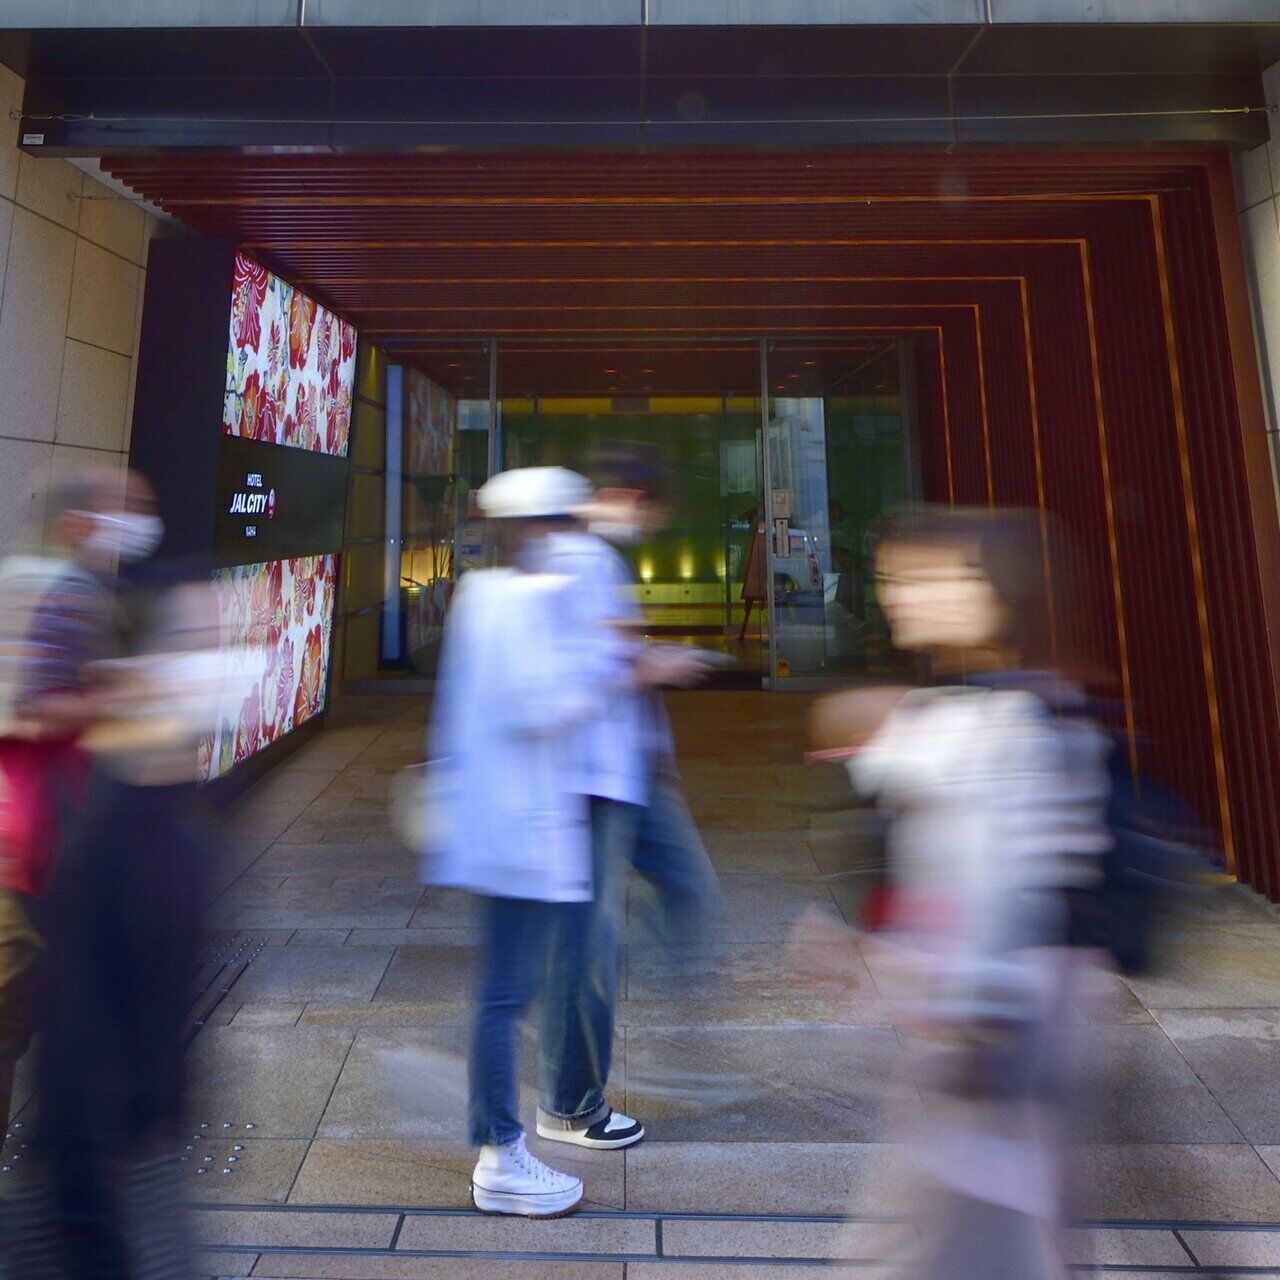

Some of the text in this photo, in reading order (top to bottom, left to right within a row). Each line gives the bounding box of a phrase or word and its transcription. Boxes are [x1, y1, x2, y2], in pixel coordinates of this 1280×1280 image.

[247, 473, 263, 487] HOTEL
[230, 493, 268, 513] JAL CITY
